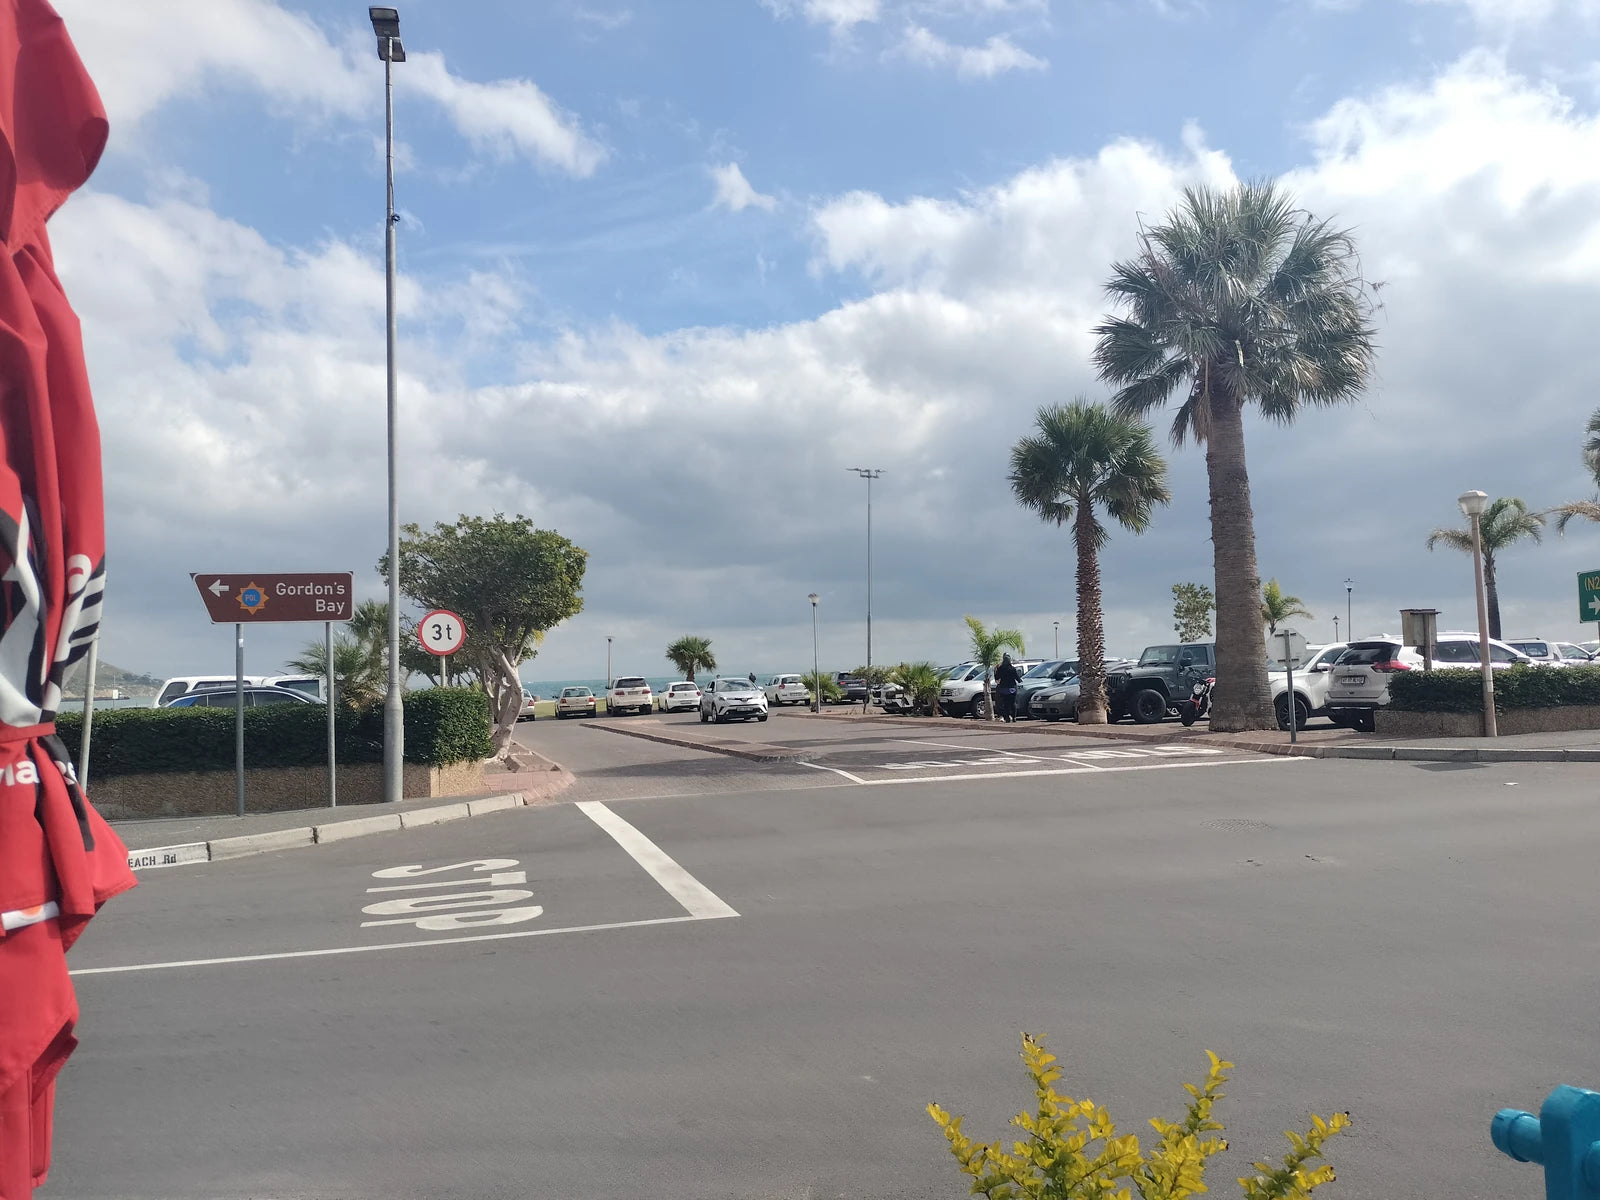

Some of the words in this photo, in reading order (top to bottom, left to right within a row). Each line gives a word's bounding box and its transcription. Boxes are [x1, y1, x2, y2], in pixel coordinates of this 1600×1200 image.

[276, 582, 345, 595] Gordon's
[244, 594, 259, 602] POL
[315, 599, 345, 615] Bay
[127, 855, 157, 868] EACH
[162, 853, 177, 865] Rd
[359, 858, 544, 931] STOP
